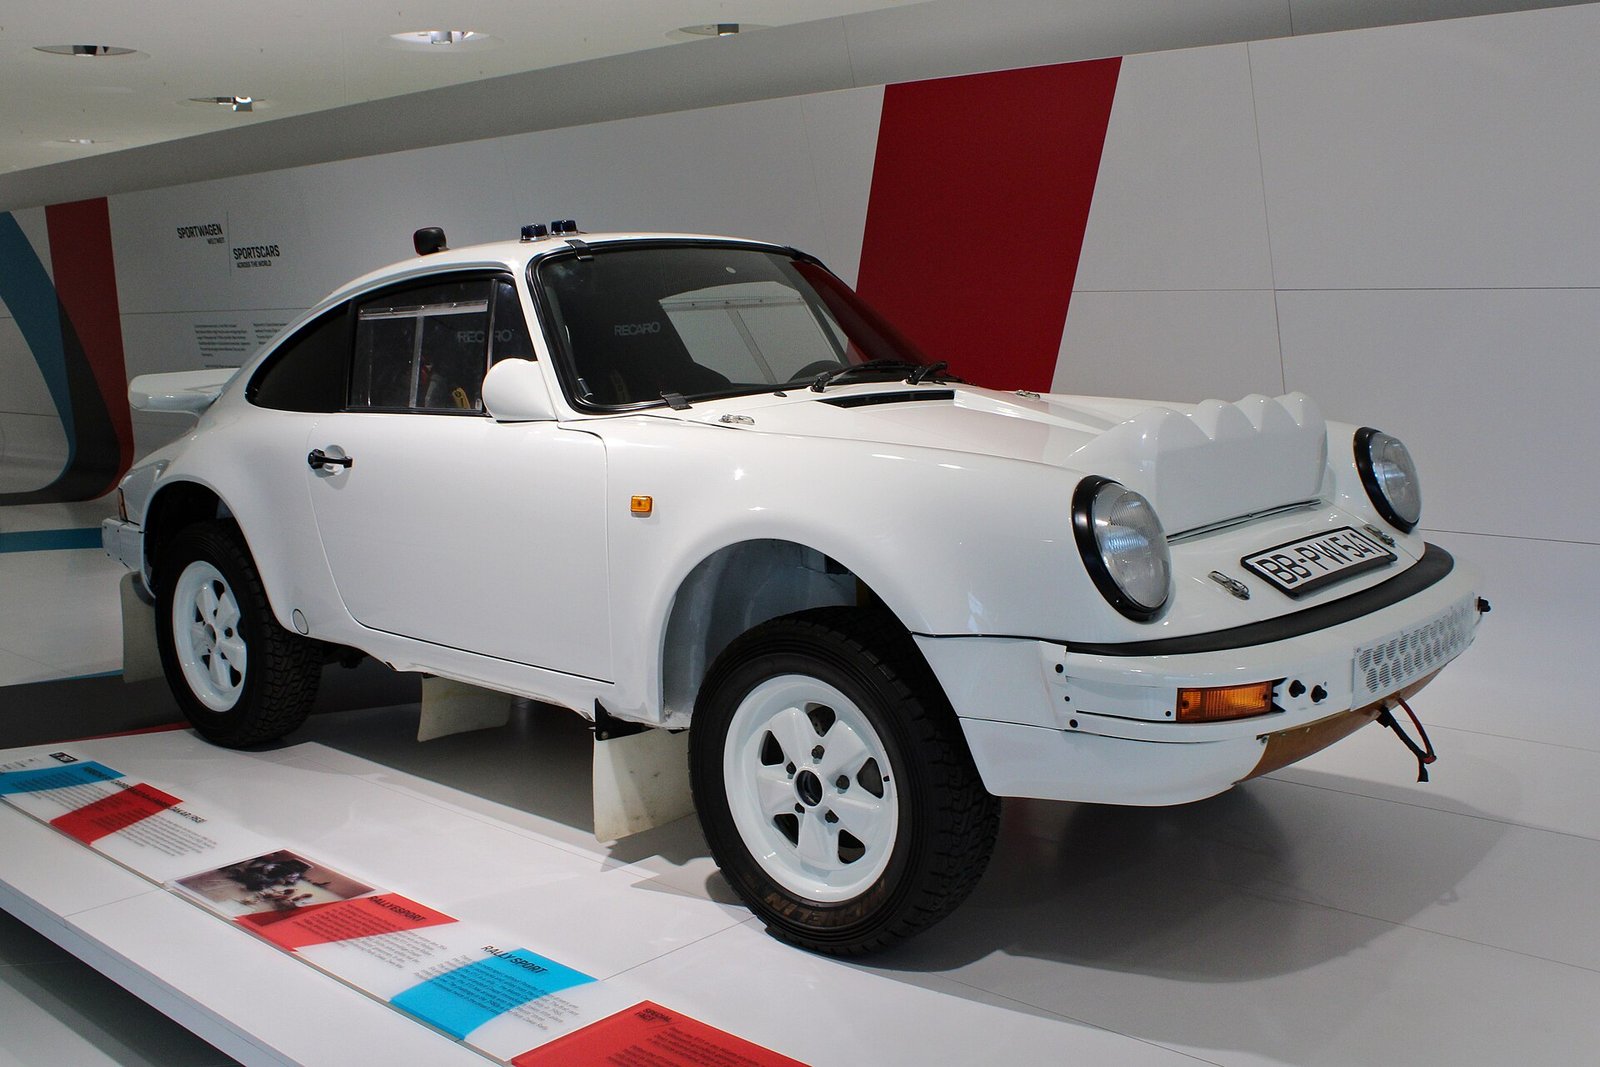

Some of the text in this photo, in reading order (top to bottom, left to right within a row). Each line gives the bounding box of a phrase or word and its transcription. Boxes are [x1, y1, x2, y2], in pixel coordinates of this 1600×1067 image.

[177, 224, 223, 239] SPORTWAGEN
[233, 245, 280, 260] SPORTSCARS
[457, 329, 512, 343] RECRO
[614, 321, 660, 337] RECARO
[369, 896, 426, 922] RALLYESPORT
